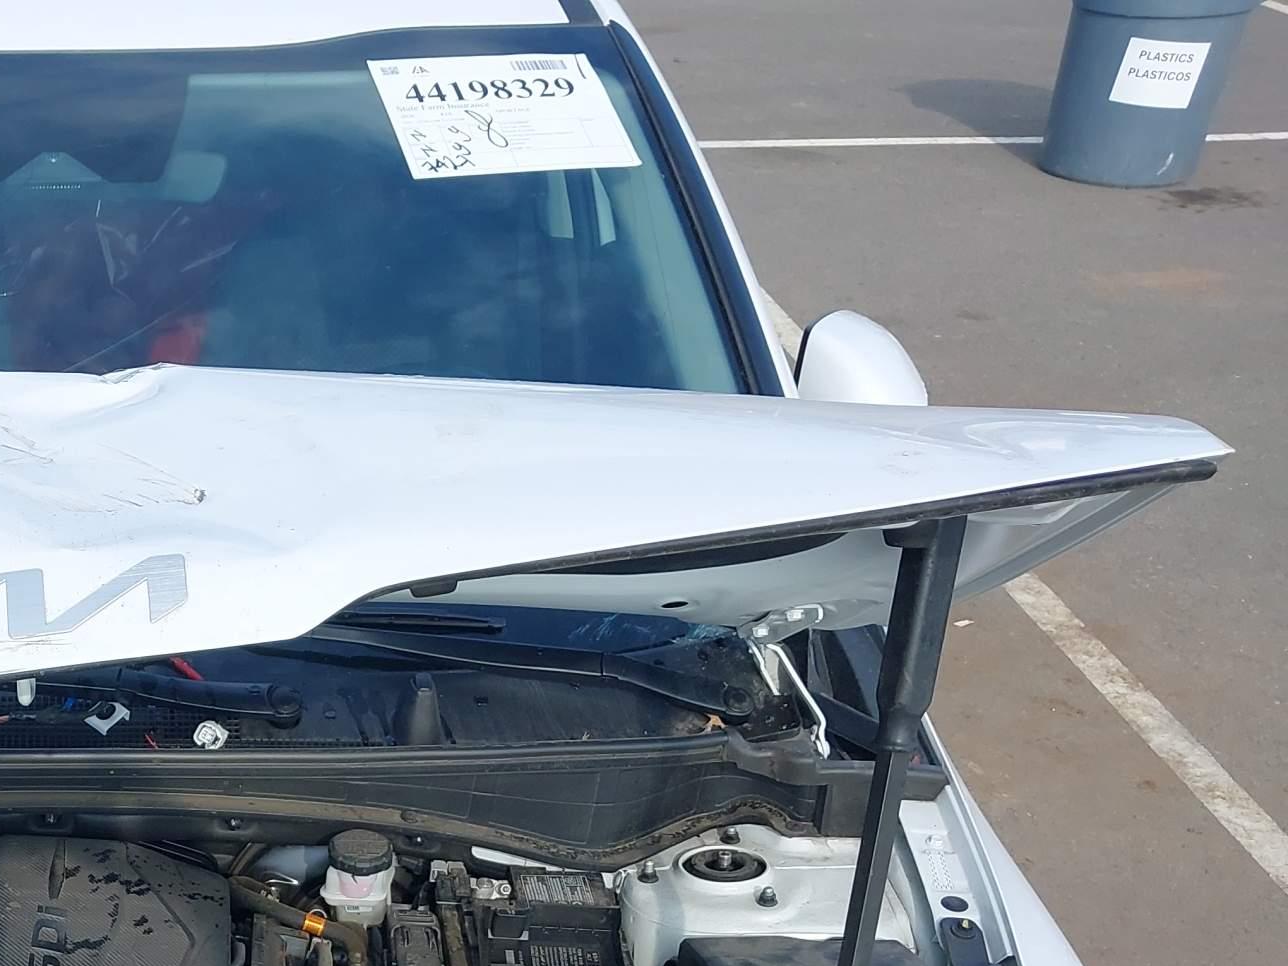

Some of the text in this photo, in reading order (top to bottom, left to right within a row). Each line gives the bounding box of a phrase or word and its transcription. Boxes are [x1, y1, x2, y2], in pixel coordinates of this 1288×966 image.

[1138, 50, 1195, 63] PLASTICS
[1128, 67, 1192, 82] PLASTICOS
[405, 78, 574, 103] 44198329
